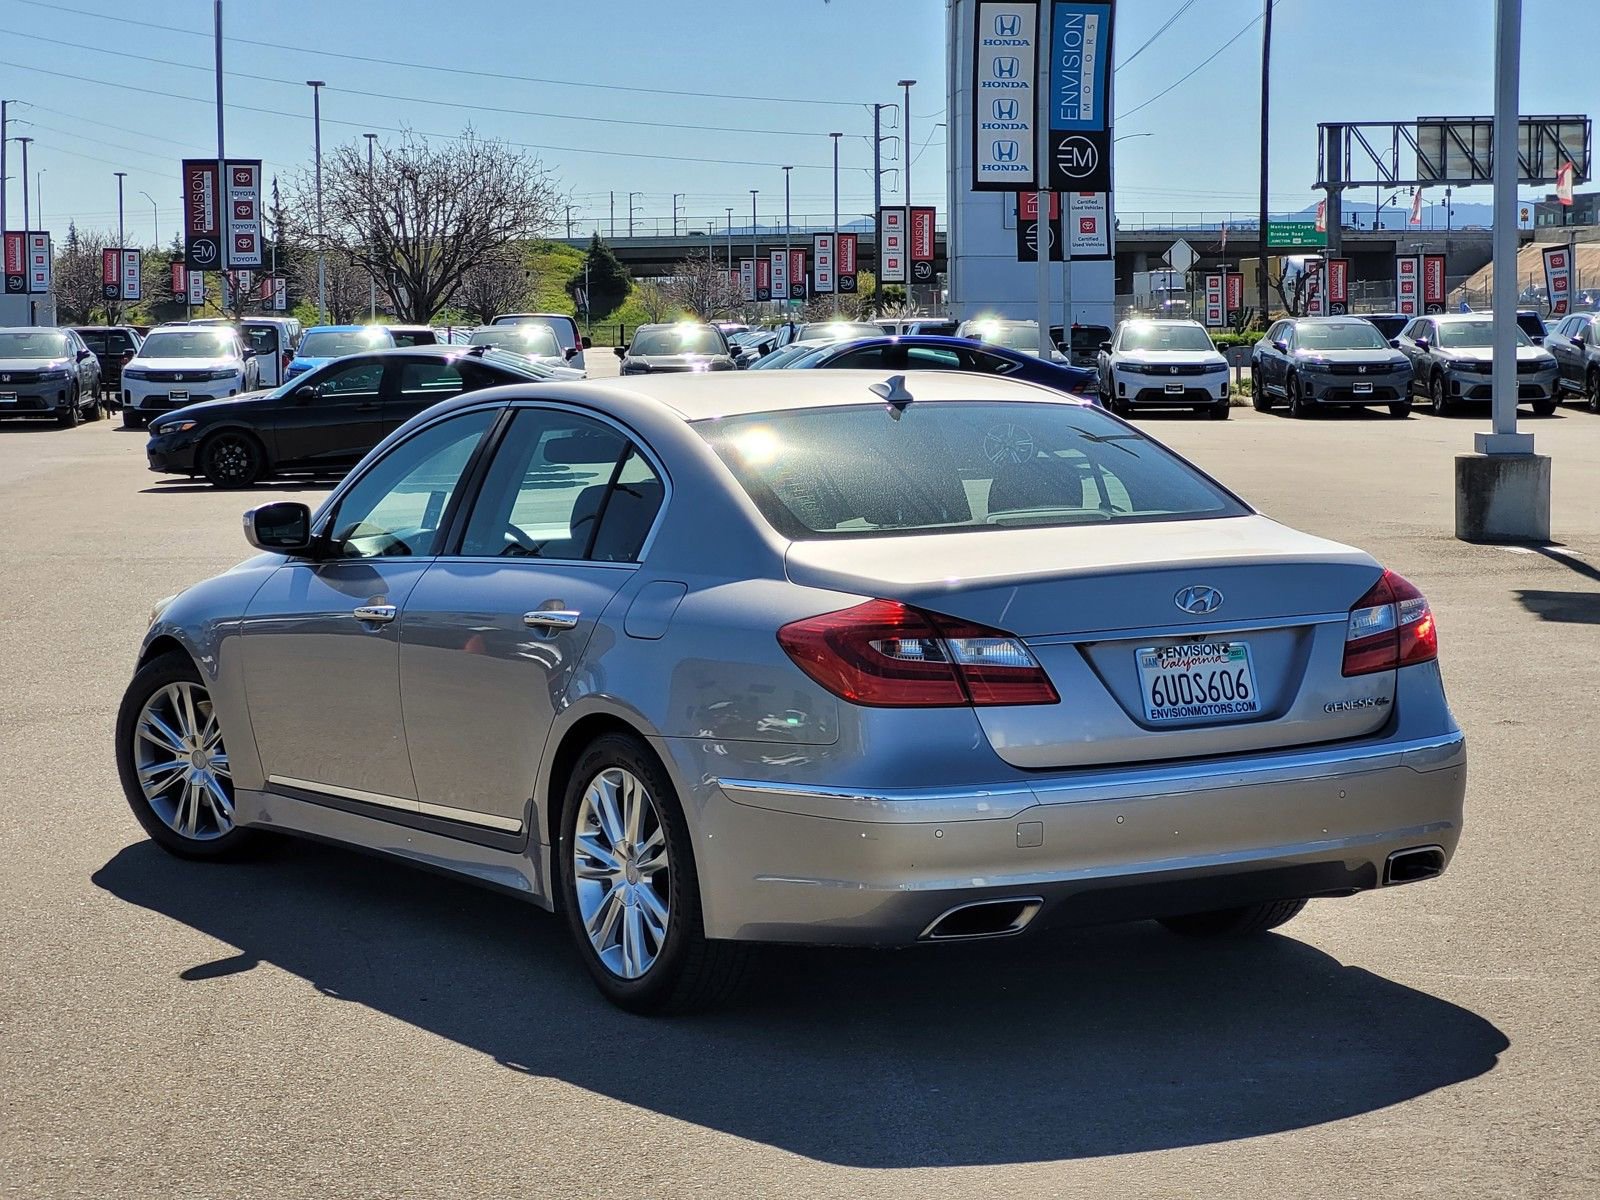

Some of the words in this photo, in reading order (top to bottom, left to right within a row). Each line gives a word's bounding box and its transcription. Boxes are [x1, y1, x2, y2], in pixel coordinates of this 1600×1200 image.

[1061, 13, 1084, 120] ENVISION
[1083, 24, 1095, 112] MOTORS
[192, 171, 205, 231] ENVISION
[915, 213, 924, 257] ENVISION
[1331, 264, 1339, 299] ENVISION
[1427, 260, 1435, 300] ENVISION
[1161, 655, 1230, 672] California
[1165, 644, 1221, 659] ENVISION
[1150, 701, 1257, 719] ENVISIONMOTORS.COM
[1323, 698, 1375, 713] GENESIS
